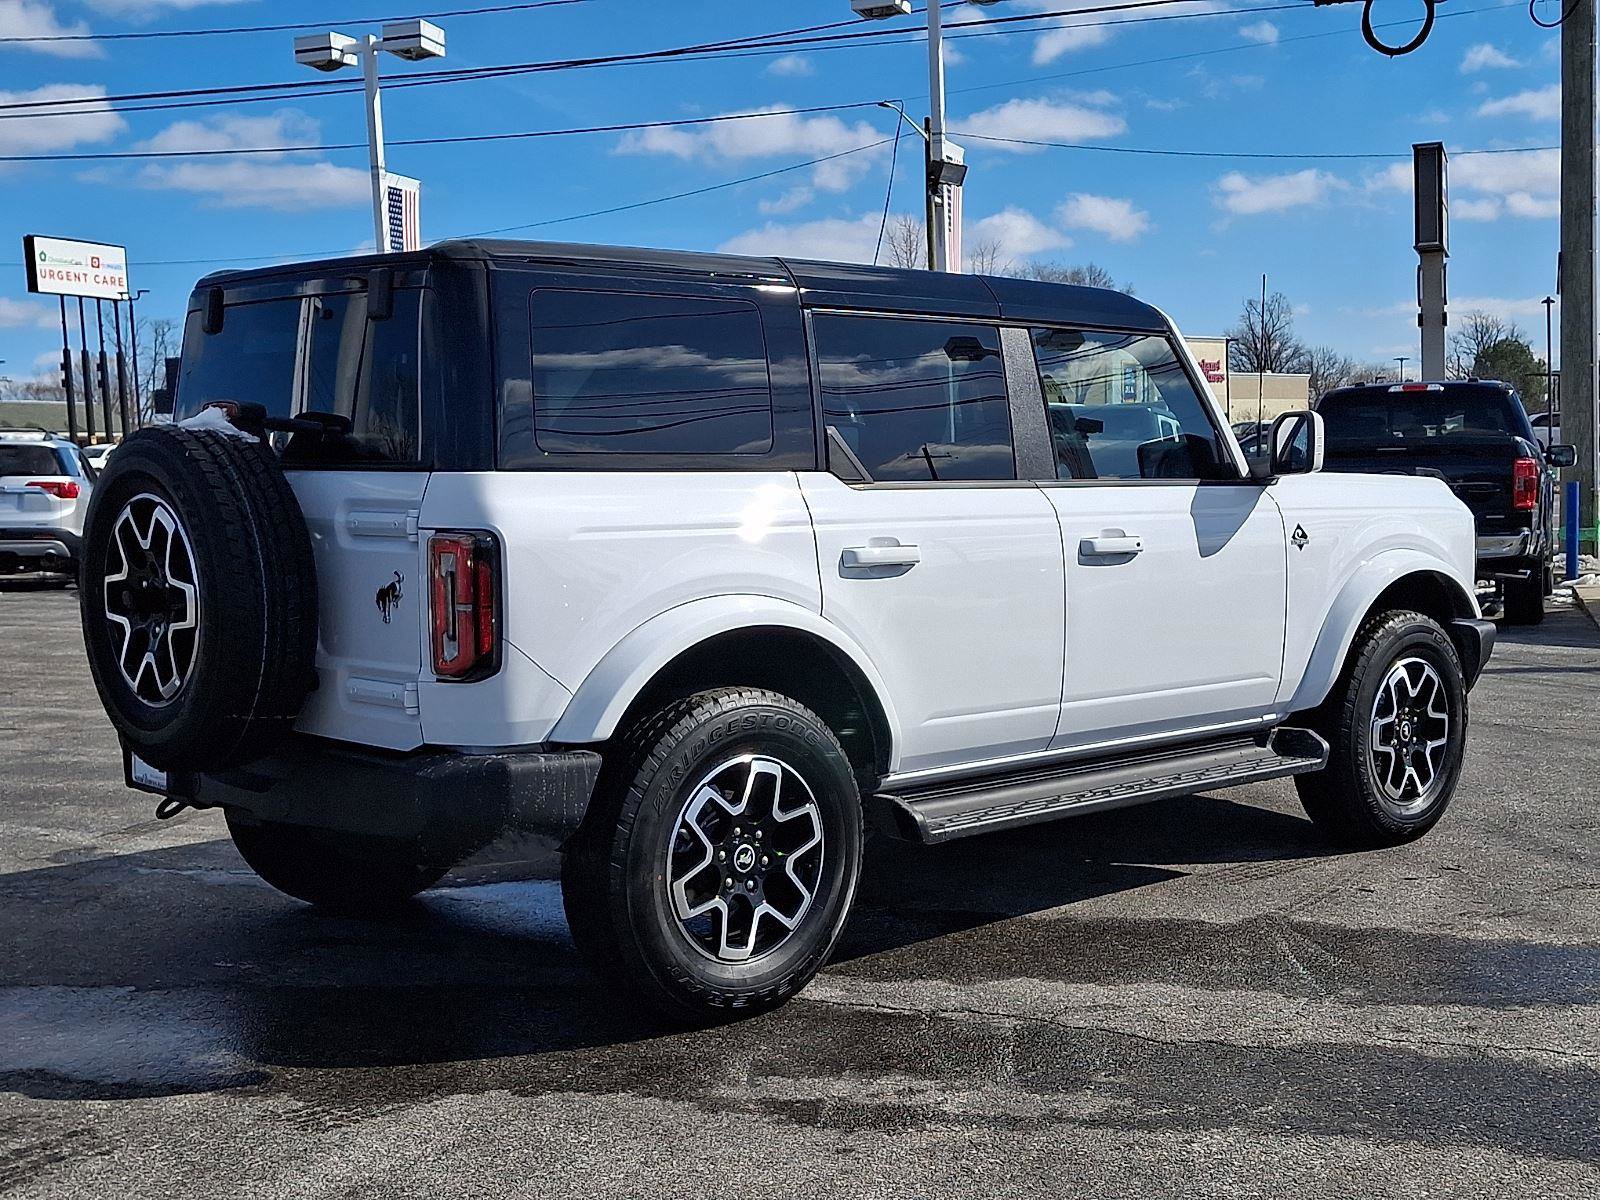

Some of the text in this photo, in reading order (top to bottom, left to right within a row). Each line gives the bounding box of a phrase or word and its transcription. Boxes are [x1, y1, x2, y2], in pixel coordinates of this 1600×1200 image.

[40, 268, 124, 287] URGENT CARE
[653, 712, 820, 816] BRIDGESTONE
